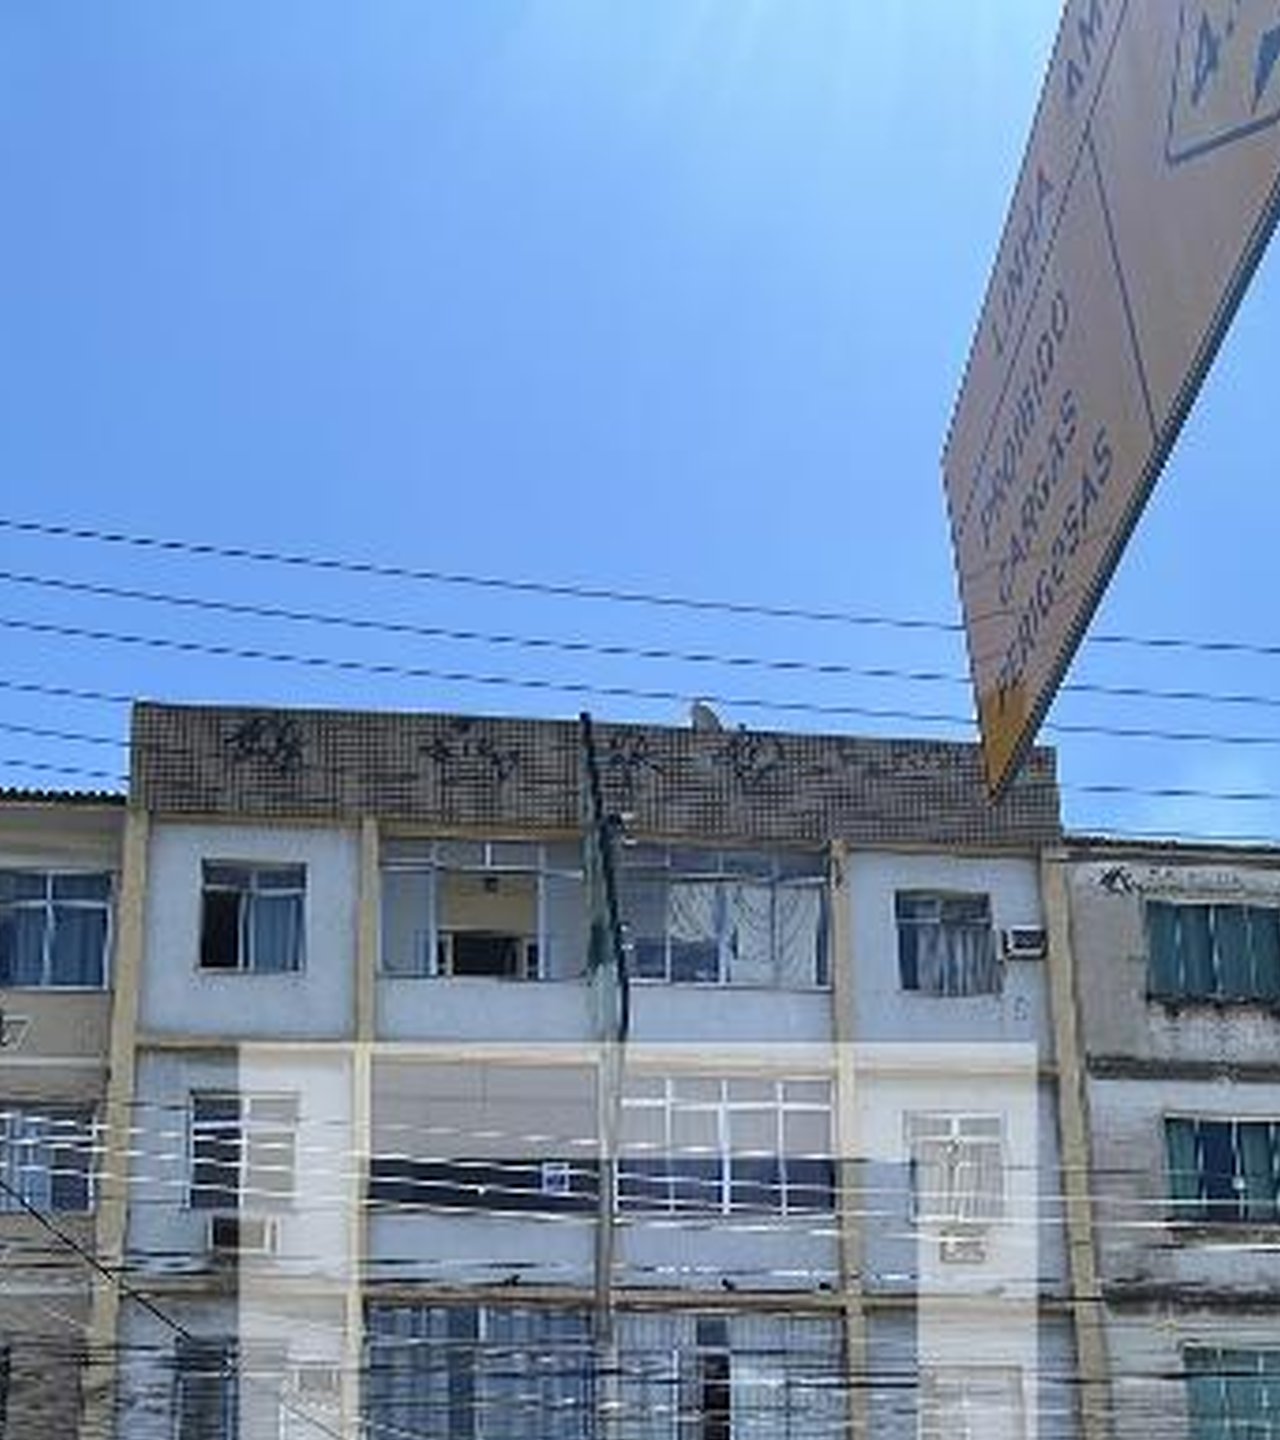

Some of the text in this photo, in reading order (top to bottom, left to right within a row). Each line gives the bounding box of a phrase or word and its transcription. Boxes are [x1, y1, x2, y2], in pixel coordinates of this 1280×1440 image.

[980, 290, 1070, 547] PROIBIDO
[1000, 389, 1078, 603] CARGAS
[997, 427, 1113, 714] PERIGOSAS
